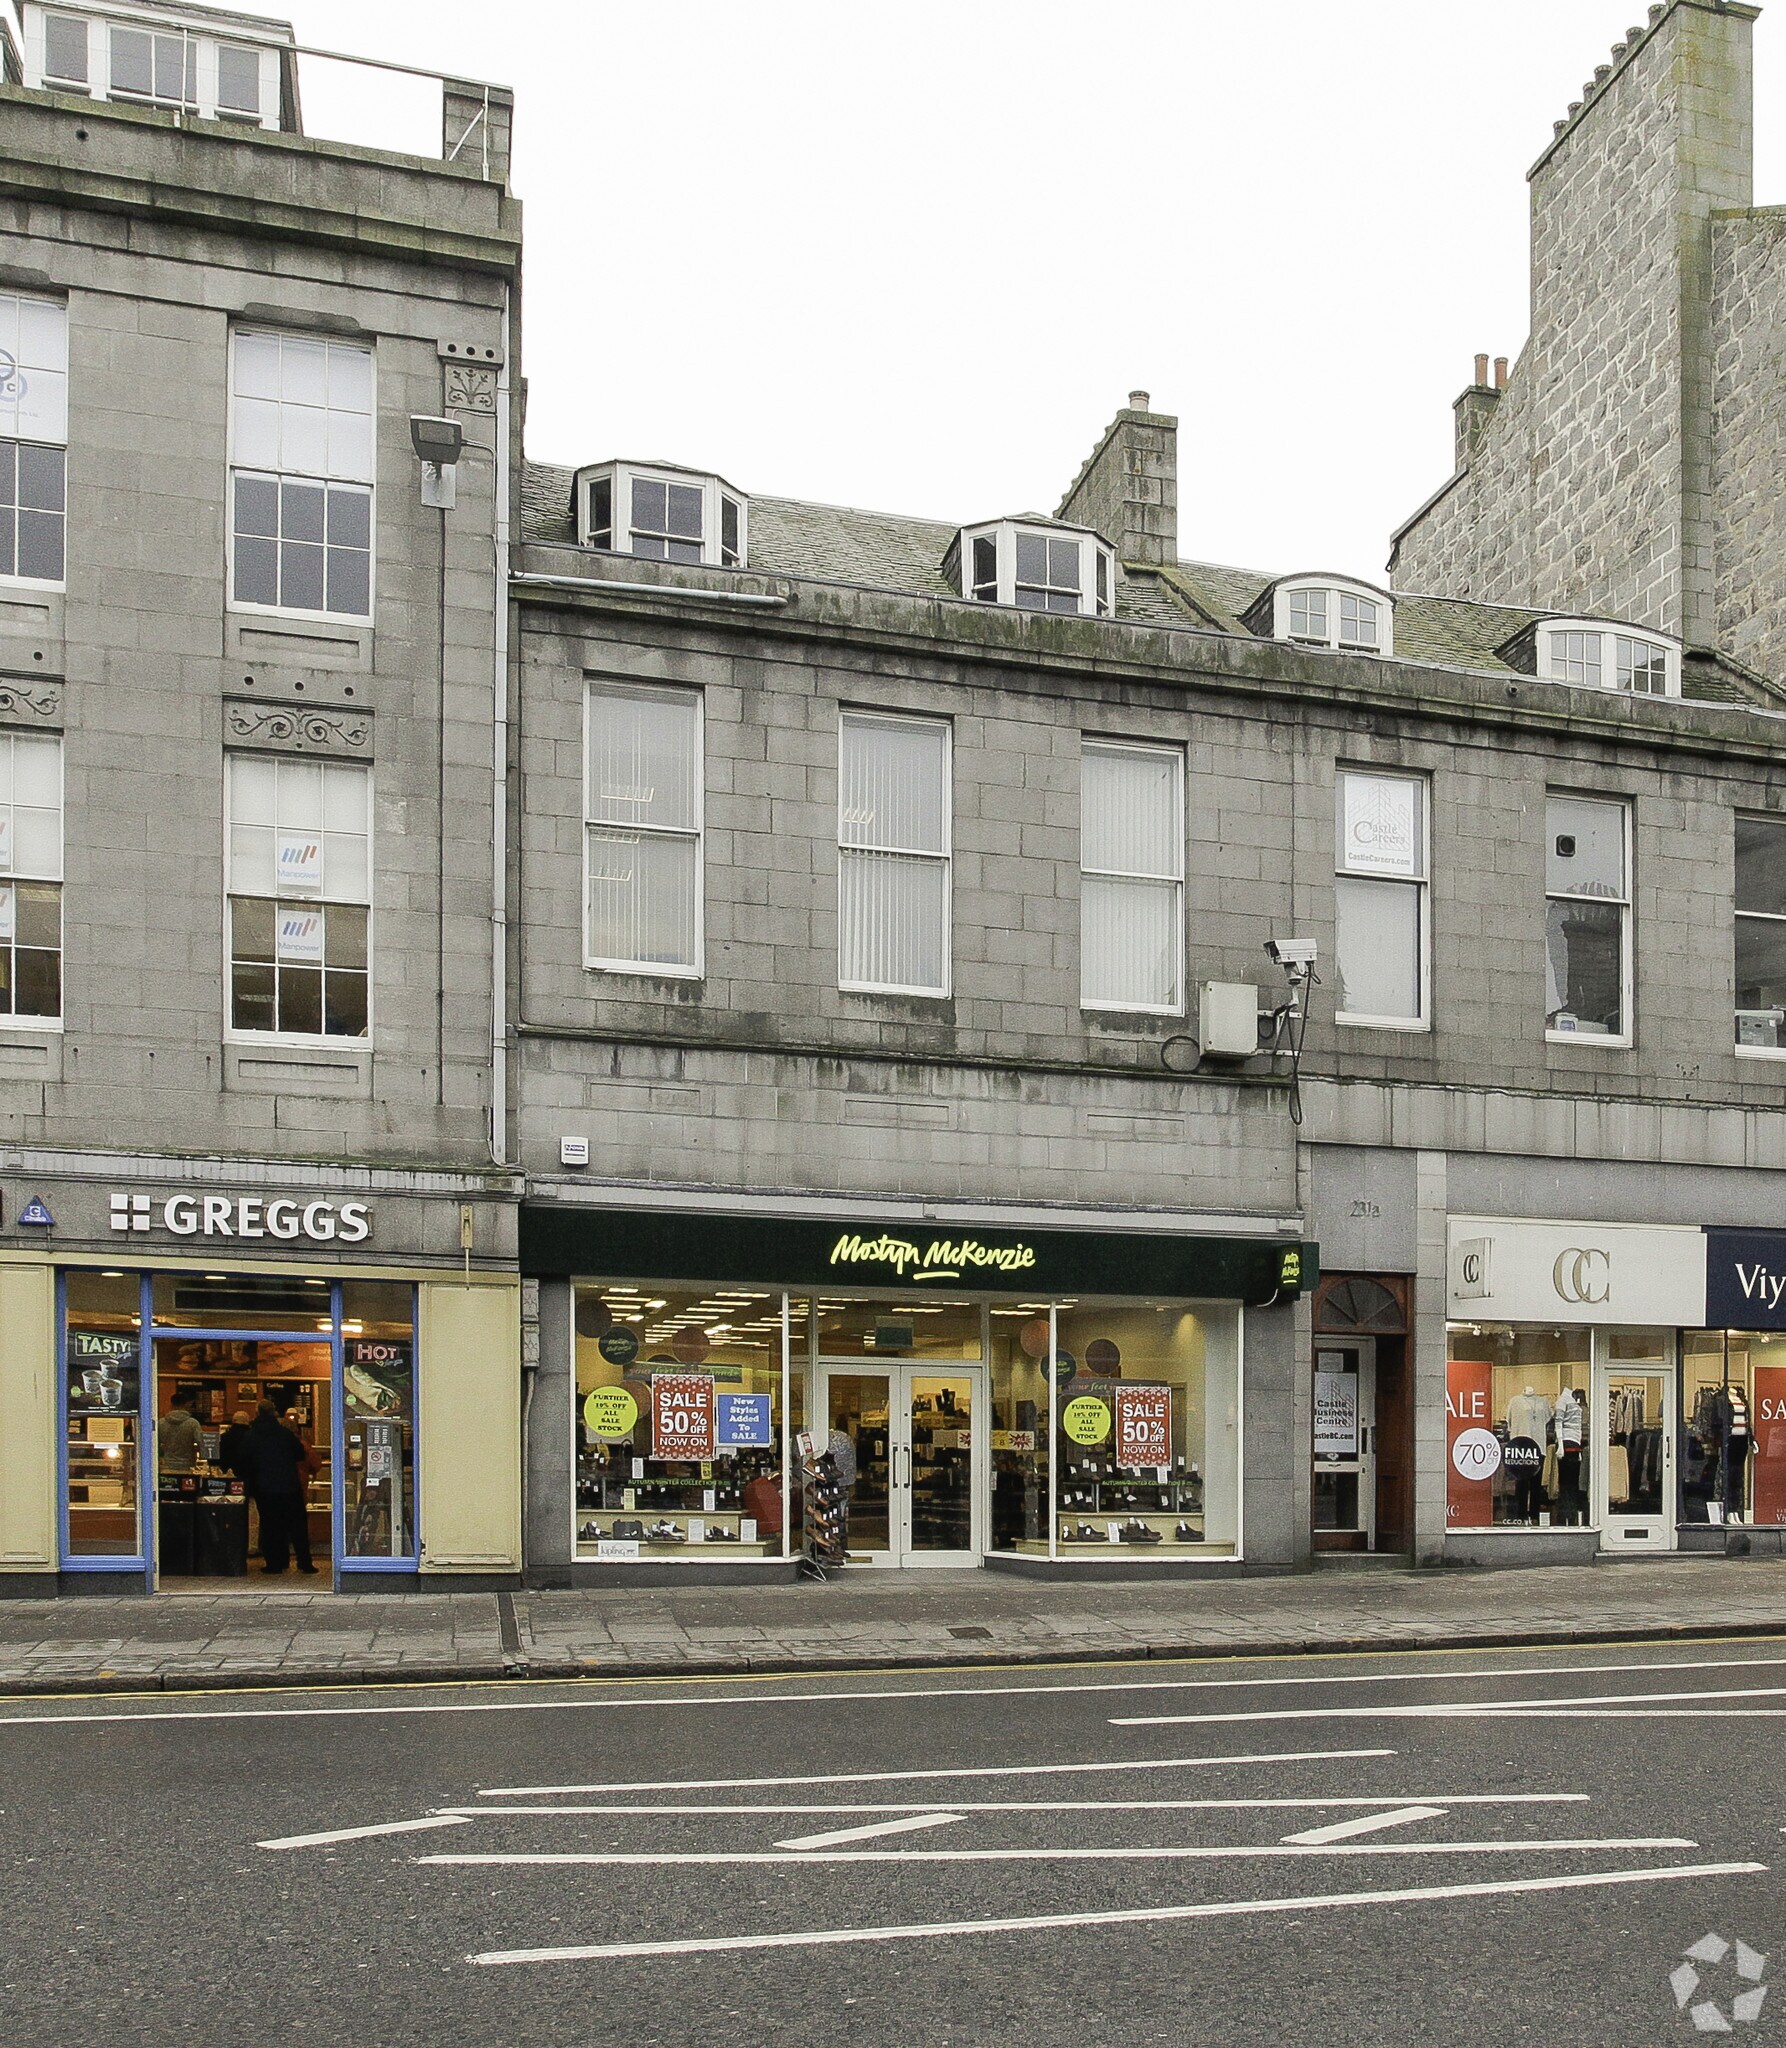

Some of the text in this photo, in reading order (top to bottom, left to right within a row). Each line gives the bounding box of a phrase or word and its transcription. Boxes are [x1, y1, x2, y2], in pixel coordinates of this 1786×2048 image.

[277, 868, 319, 879] Manpower
[277, 941, 319, 952] Manpower
[1350, 1200, 1380, 1218] 231a
[163, 1194, 370, 1242] GREGGS
[830, 1234, 1036, 1275] Mostyn McKenzie
[1553, 1247, 1610, 1304] CC
[1734, 1263, 1786, 1310] Viy
[77, 1335, 128, 1353] TASTY
[357, 1344, 397, 1360] HOT
[659, 1392, 707, 1408] SALE
[1317, 1400, 1347, 1408] Castle
[729, 1406, 759, 1414] Styles
[1122, 1403, 1165, 1417] SALE
[660, 1411, 707, 1433] 50%
[1316, 1417, 1348, 1426] Centre
[690, 1425, 707, 1434] OFF
[731, 1432, 758, 1440] SALE
[1123, 1421, 1165, 1442] 50%
[660, 1437, 708, 1446] NOW ON
[1150, 1434, 1165, 1442] OFF
[1123, 1446, 1165, 1454] NOW ON
[1459, 1443, 1499, 1465] 70%
[1504, 1447, 1540, 1459] FINAL
